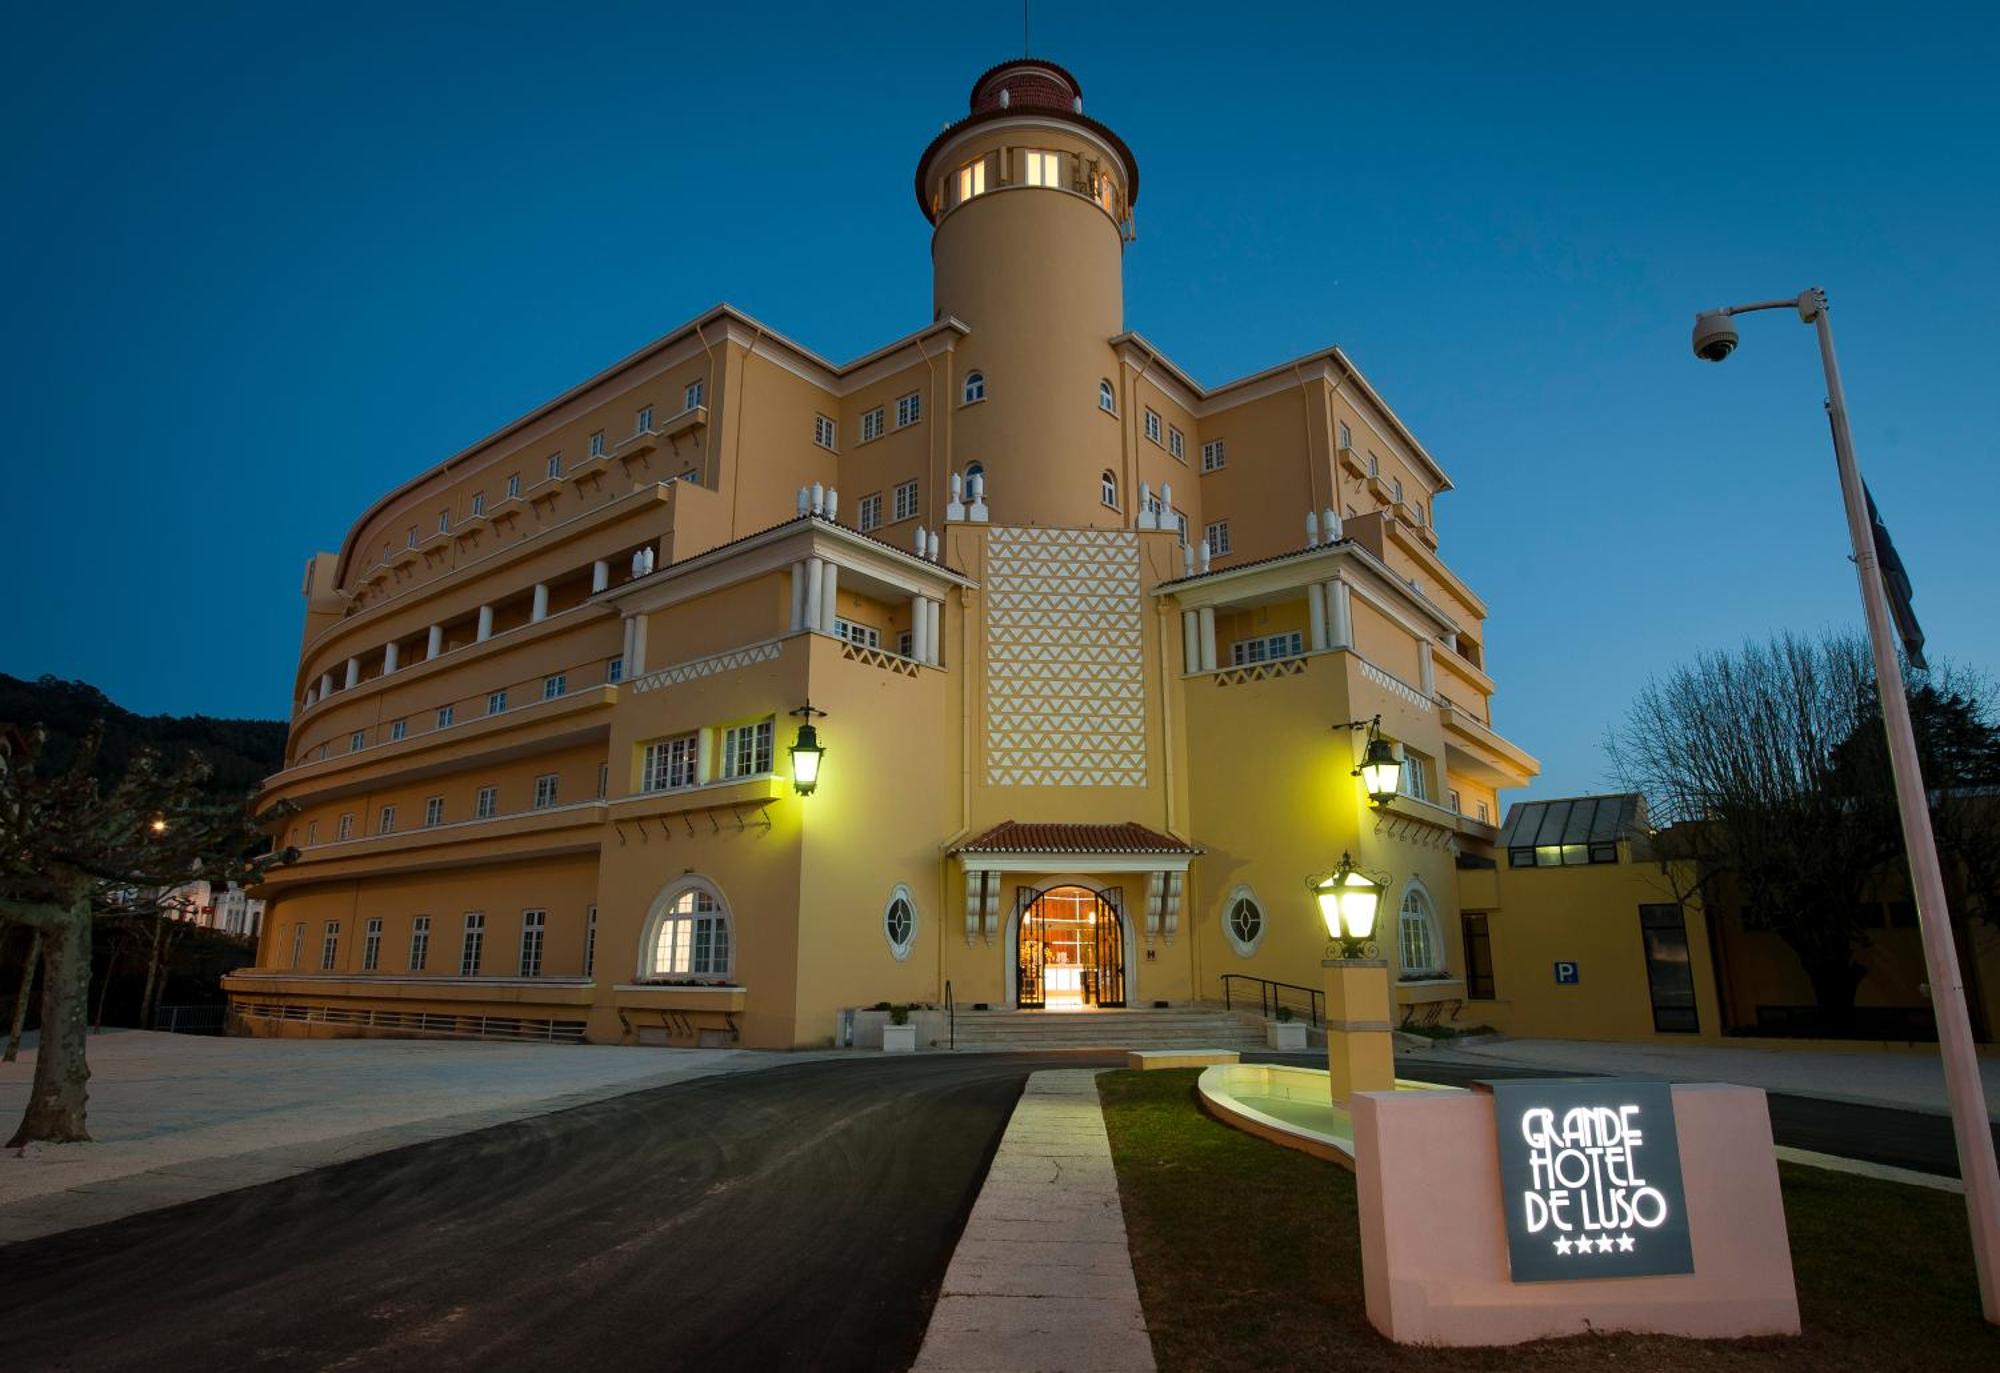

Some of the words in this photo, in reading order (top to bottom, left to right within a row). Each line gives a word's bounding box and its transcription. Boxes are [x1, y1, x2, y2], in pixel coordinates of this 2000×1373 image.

[1558, 963, 1574, 982] P
[1522, 1105, 1643, 1148] GRANDE
[1529, 1147, 1646, 1190] HOTEL
[1524, 1190, 1573, 1233] DE
[1580, 1187, 1667, 1230] LUSO
